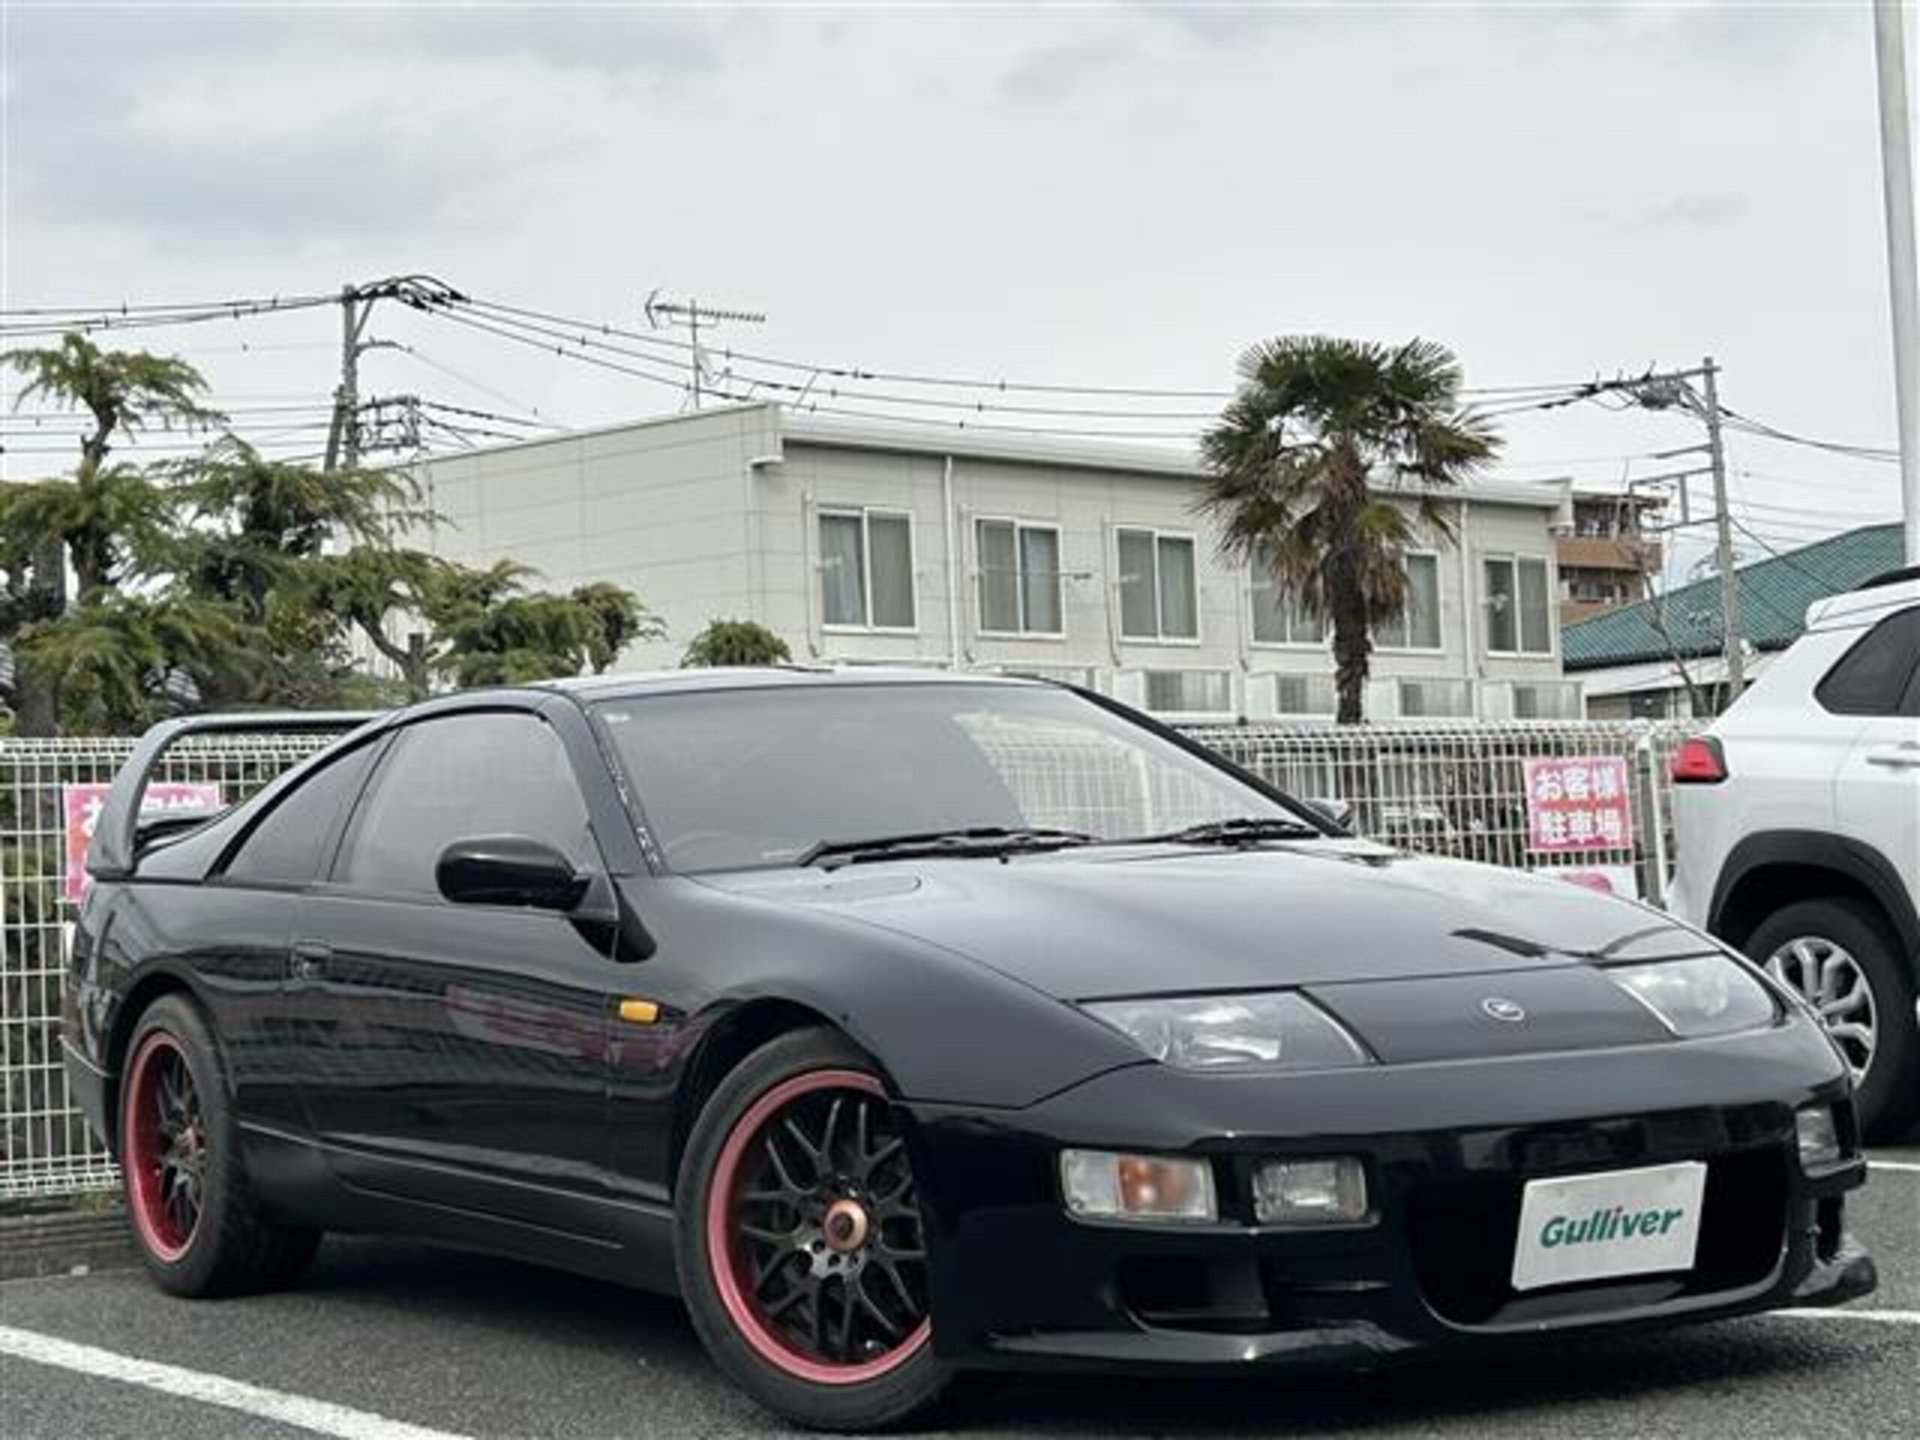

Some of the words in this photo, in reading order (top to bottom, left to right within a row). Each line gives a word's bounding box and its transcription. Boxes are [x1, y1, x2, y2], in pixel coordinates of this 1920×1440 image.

[1535, 765, 1616, 800] お客様
[1538, 808, 1621, 844] 駐車場
[1540, 1206, 1683, 1248] Gulliver
